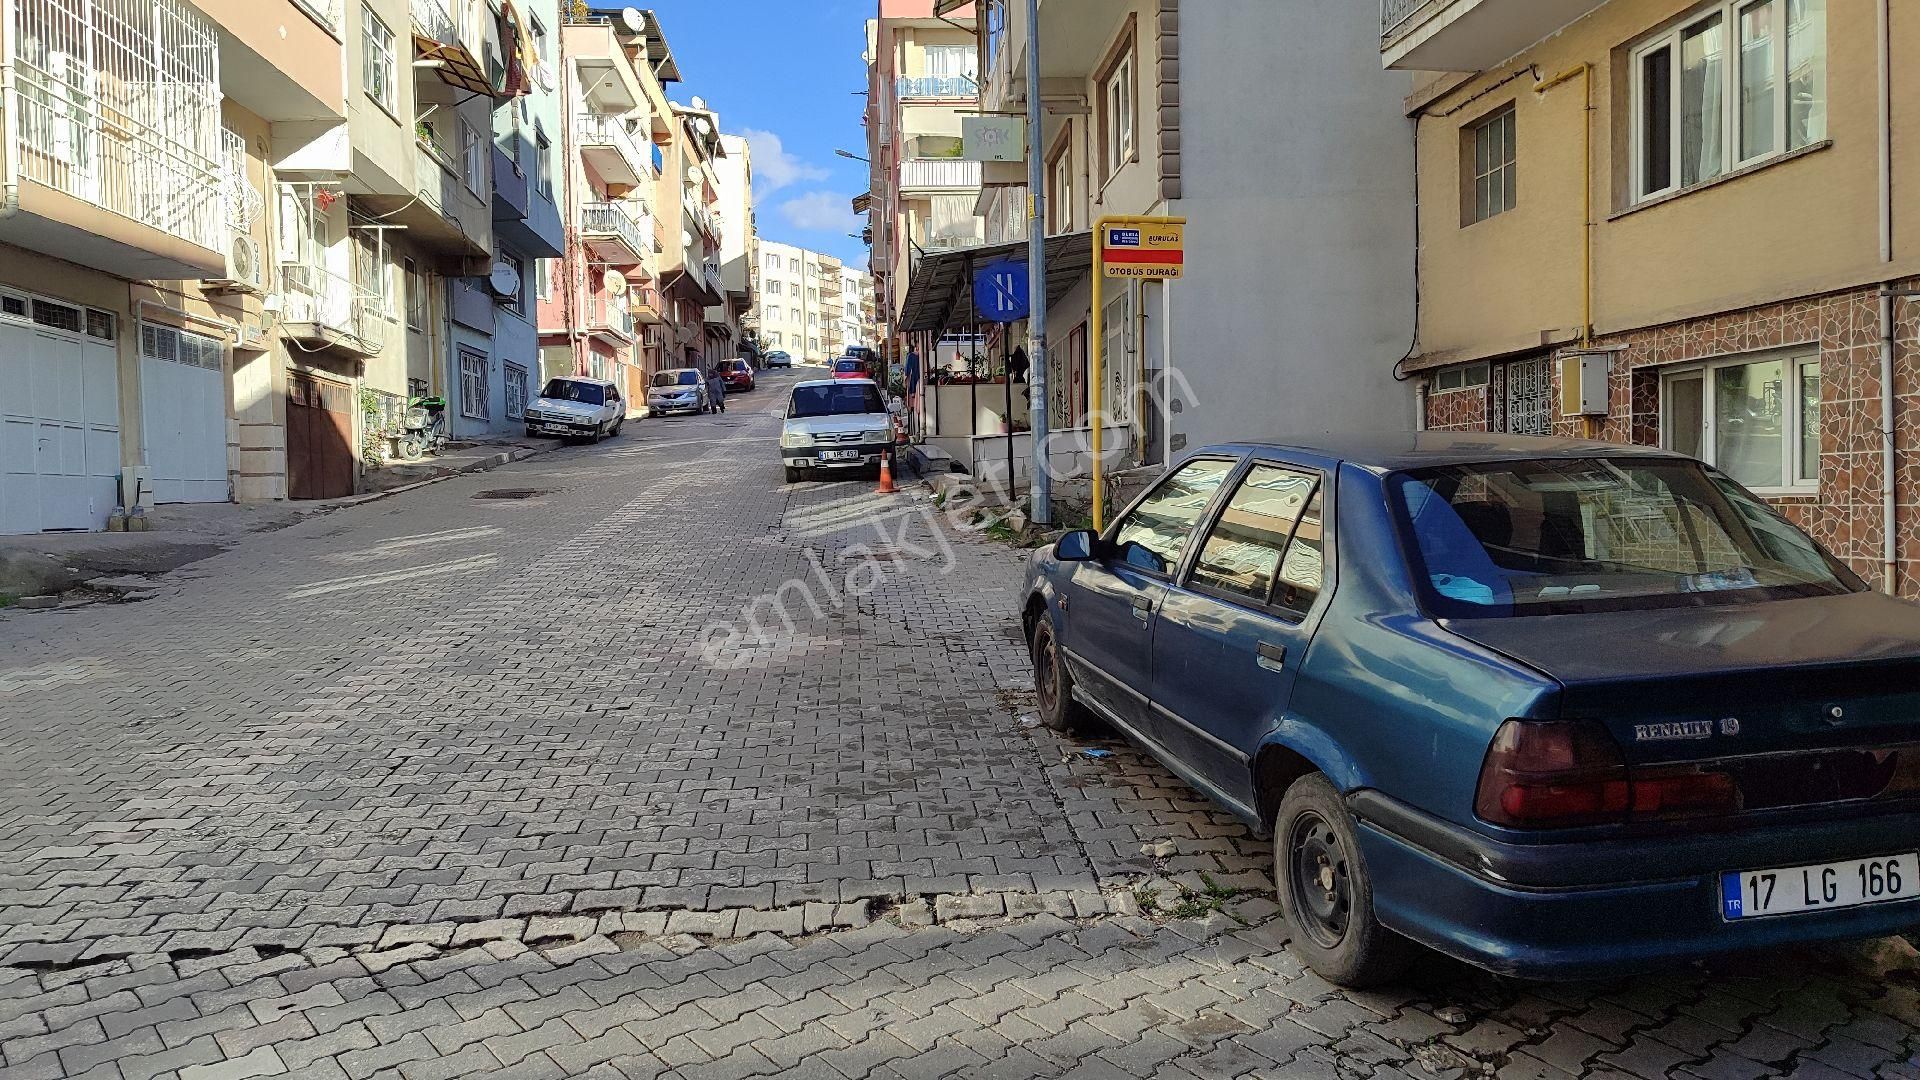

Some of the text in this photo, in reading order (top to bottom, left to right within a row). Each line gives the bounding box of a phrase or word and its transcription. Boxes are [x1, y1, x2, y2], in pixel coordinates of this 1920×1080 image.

[1109, 267, 1179, 276] OTOBÜS DURAĞI
[1634, 717, 1740, 741] RENAULT 19
[1727, 859, 1902, 911] TR 17 LG 166
